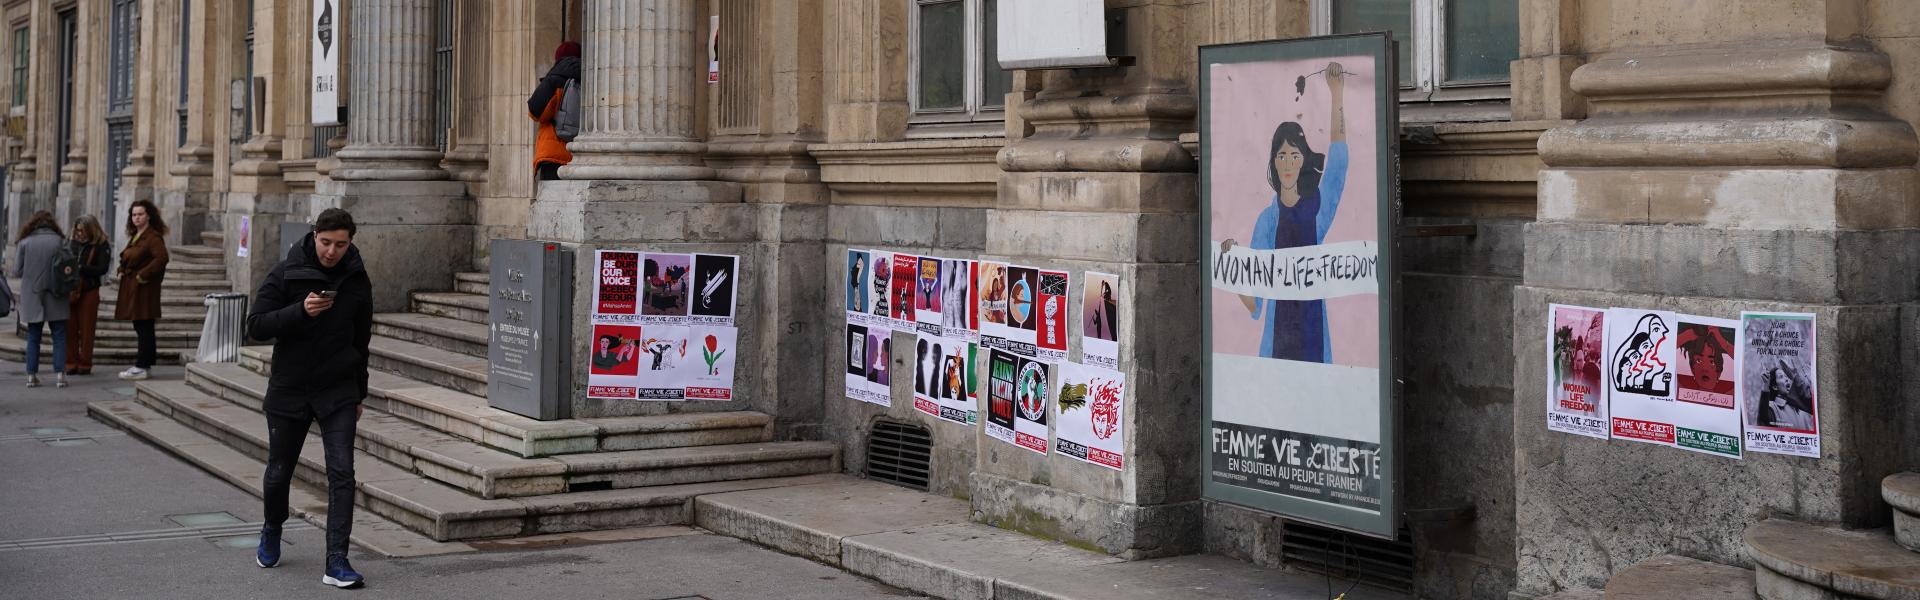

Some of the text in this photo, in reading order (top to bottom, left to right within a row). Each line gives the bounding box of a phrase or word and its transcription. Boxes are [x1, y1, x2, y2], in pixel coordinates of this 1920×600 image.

[604, 260, 616, 268] BE
[1214, 250, 1274, 288] WOMAN
[1321, 254, 1378, 282] FREEDOM
[603, 277, 630, 285] VOICE
[1563, 383, 1591, 394] WOMAN
[1570, 393, 1585, 402] LIFE
[1560, 400, 1595, 412] FREEDOM
[1747, 432, 1771, 441] FEMME
[1773, 435, 1785, 443] VIE
[1212, 428, 1267, 459] FEMME
[1306, 442, 1380, 480] LIBERTÉ
[1229, 458, 1363, 492] EN SOUTIEN AU PEUPLE IRANIEN
